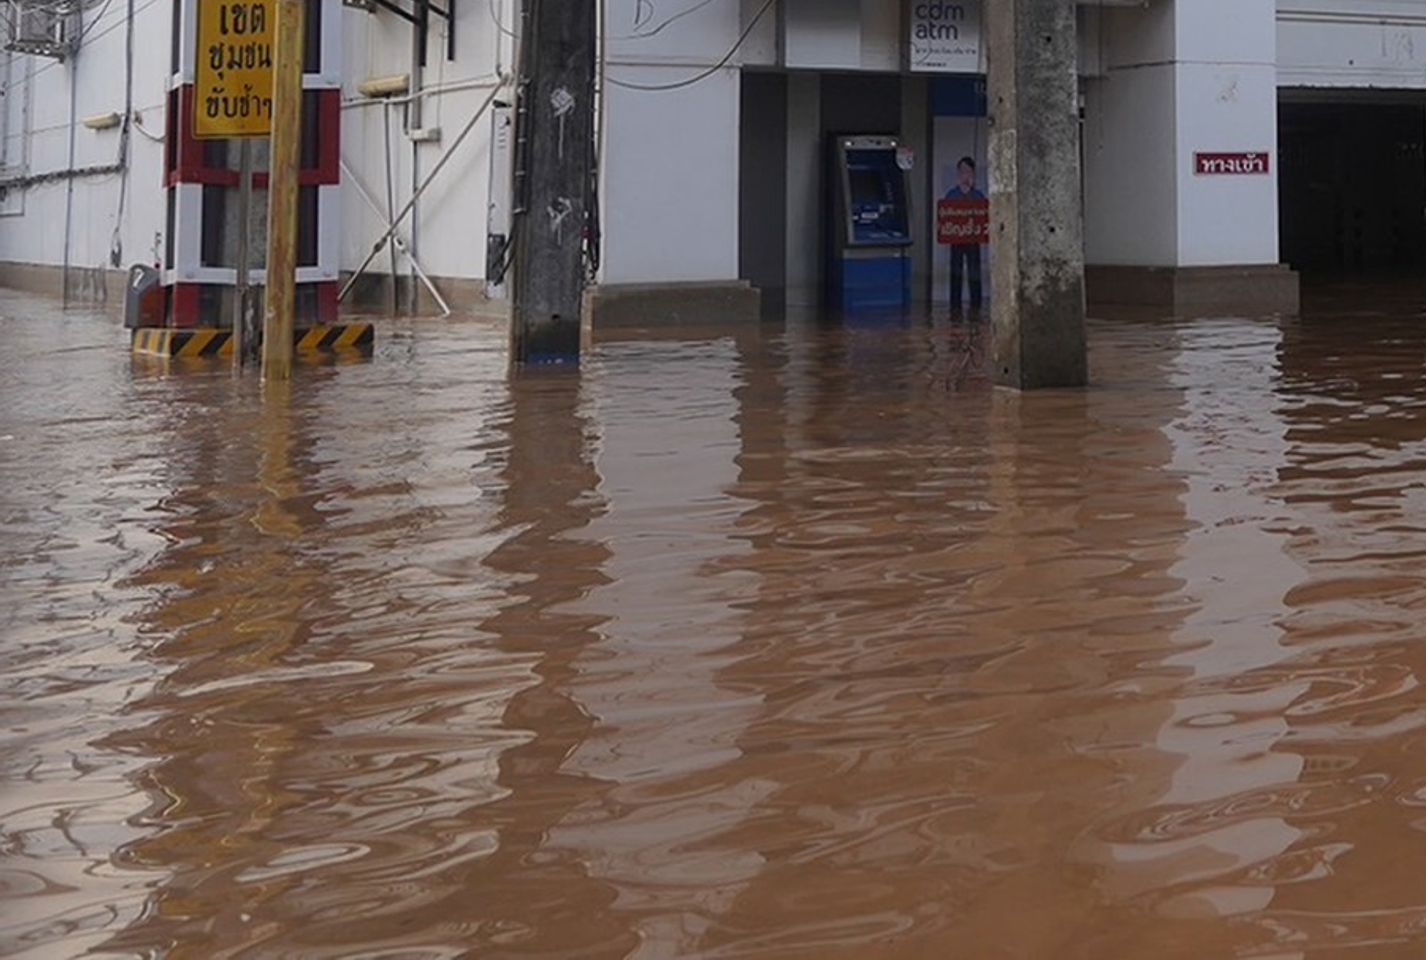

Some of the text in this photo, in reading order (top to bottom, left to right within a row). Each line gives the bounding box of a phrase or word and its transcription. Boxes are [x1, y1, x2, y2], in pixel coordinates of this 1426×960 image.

[915, 0, 964, 20] cdm
[915, 21, 958, 40] atm
[208, 42, 271, 80] ชุมชน
[1201, 153, 1264, 173] ทางเข้า
